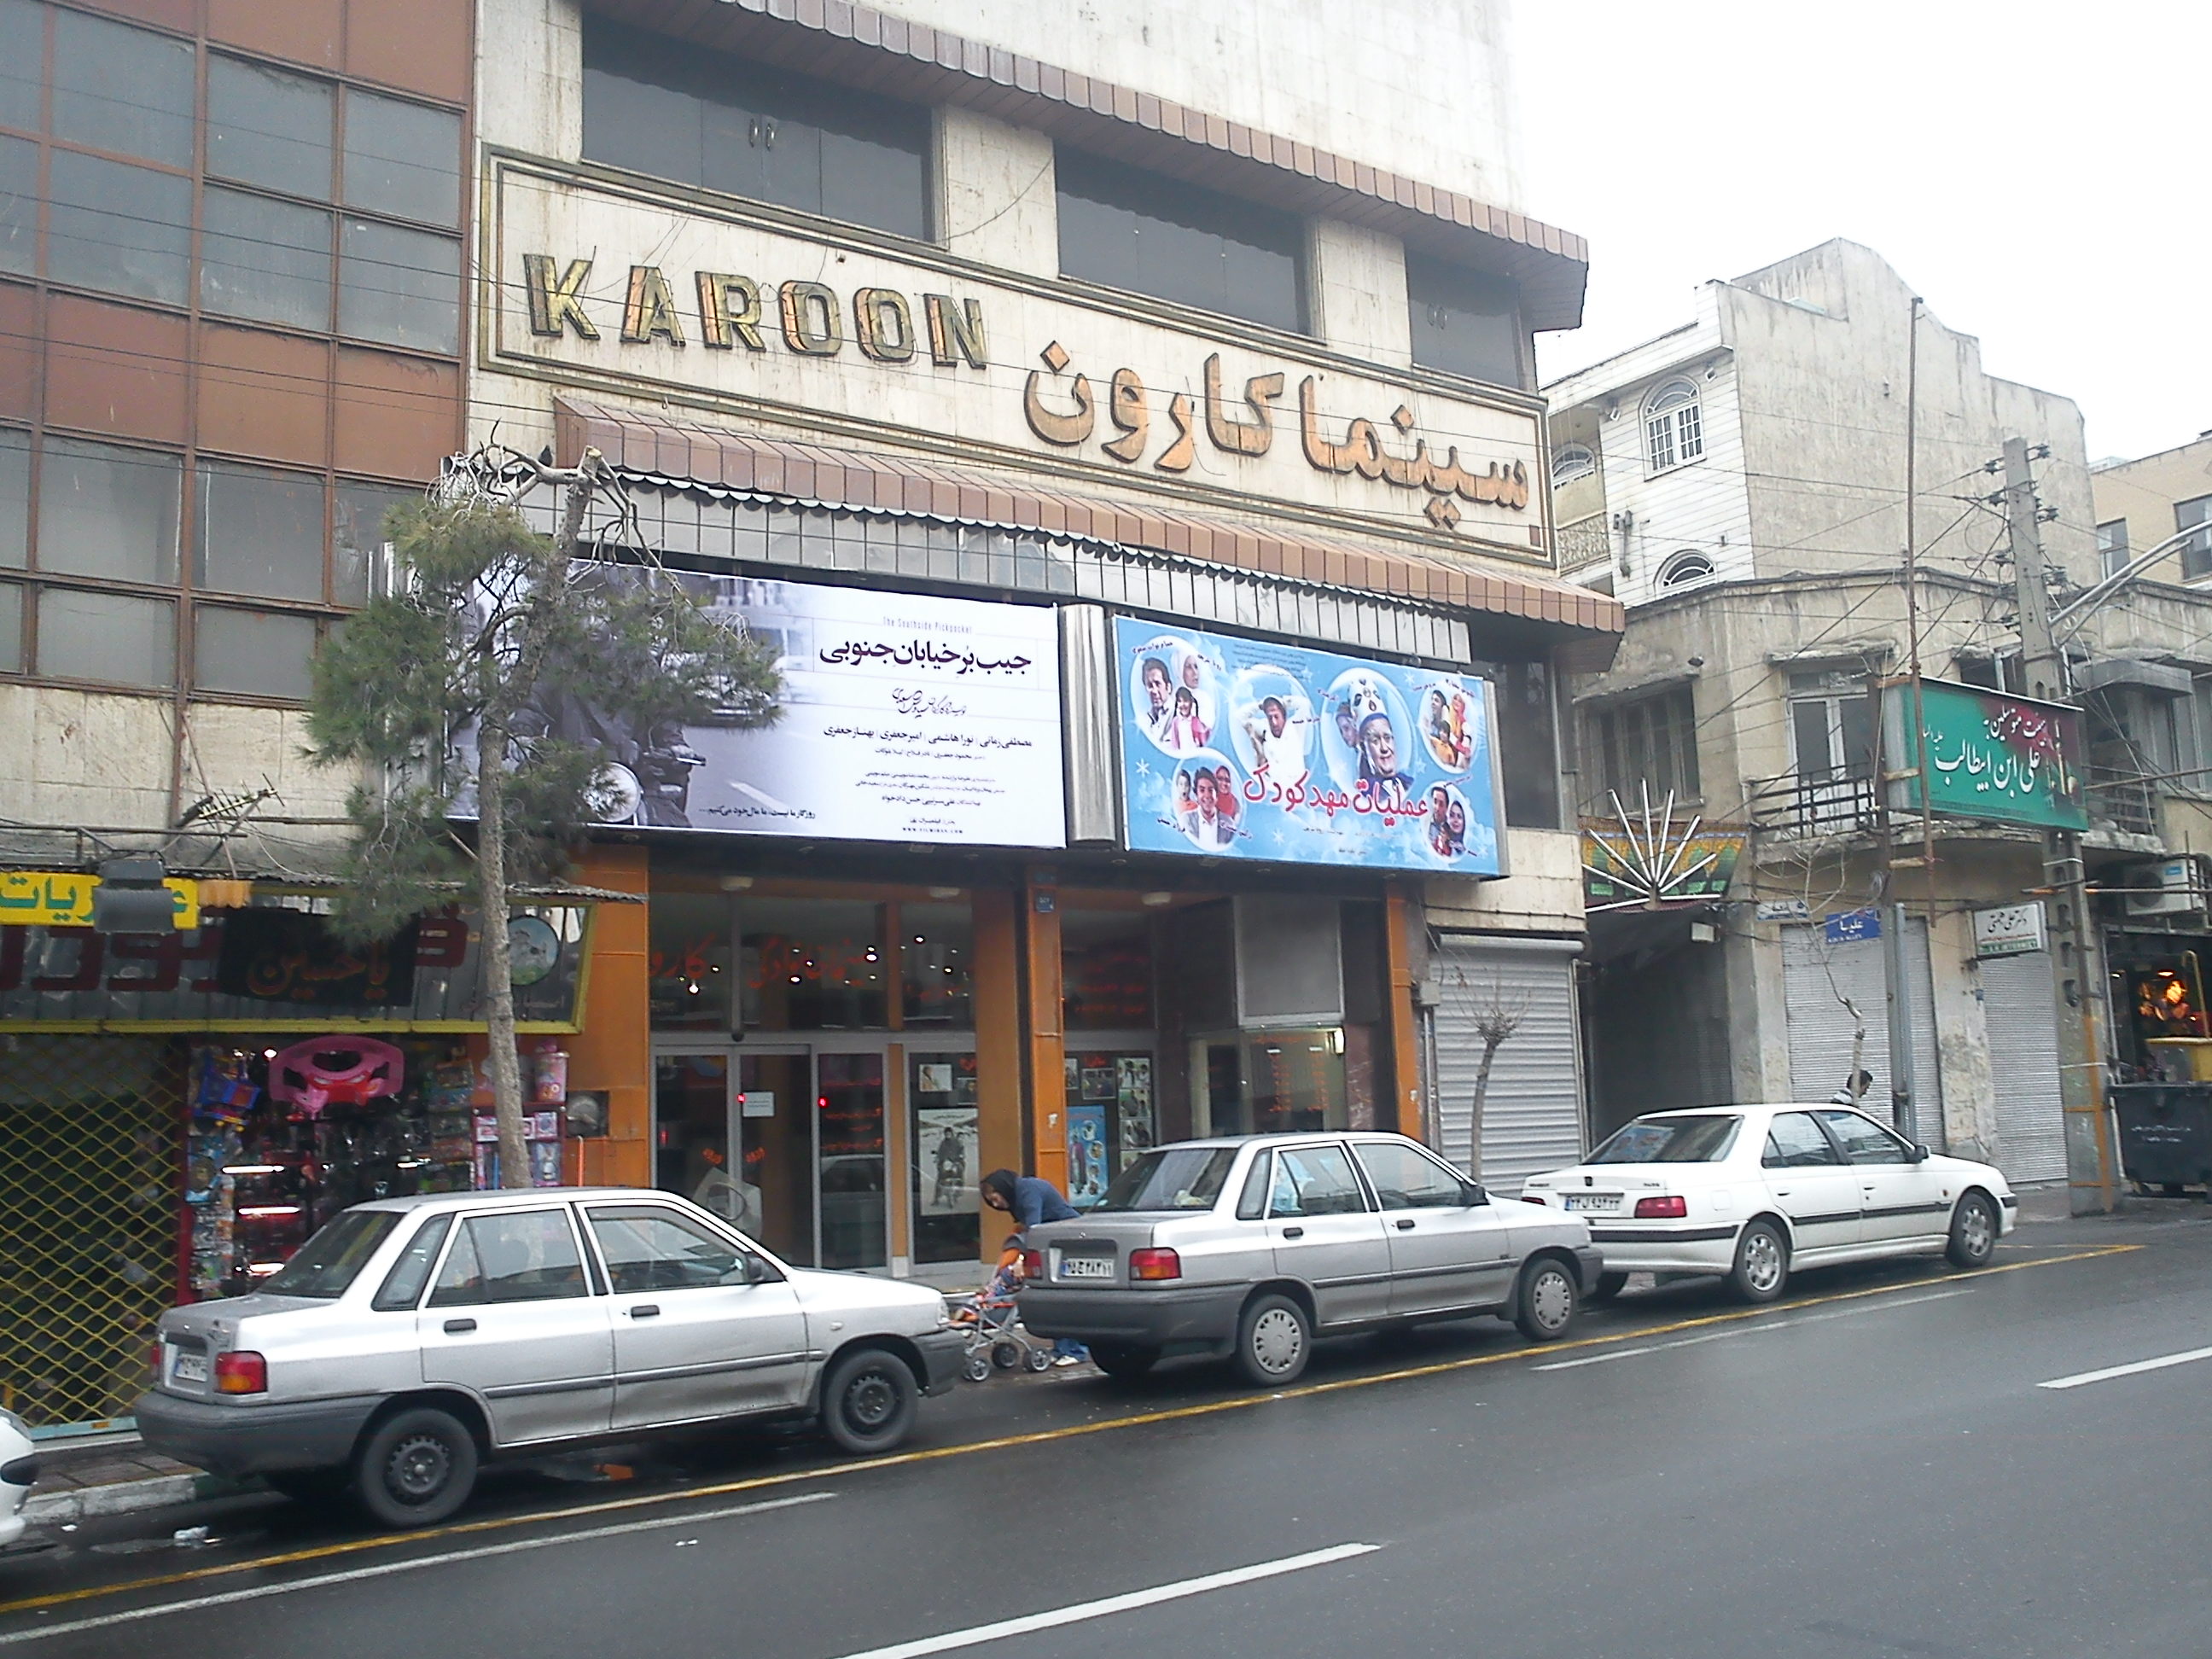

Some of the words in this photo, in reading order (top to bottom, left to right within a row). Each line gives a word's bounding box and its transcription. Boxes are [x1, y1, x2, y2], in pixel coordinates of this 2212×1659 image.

[522, 253, 987, 370] KAROON
[1024, 340, 1285, 473] کارون
[1300, 375, 1530, 529] سینما
[882, 616, 895, 628] The
[898, 618, 933, 632] Southside
[935, 621, 973, 635] Pickpocket
[819, 640, 894, 666] جنوبی
[894, 639, 961, 670] خیابان
[976, 655, 1032, 675] جیب
[1994, 754, 2017, 798] ابن
[2019, 746, 2041, 794] علی
[1309, 785, 1349, 817] مهد
[1353, 779, 1429, 827] عملیات
[247, 950, 368, 1001] حسین
